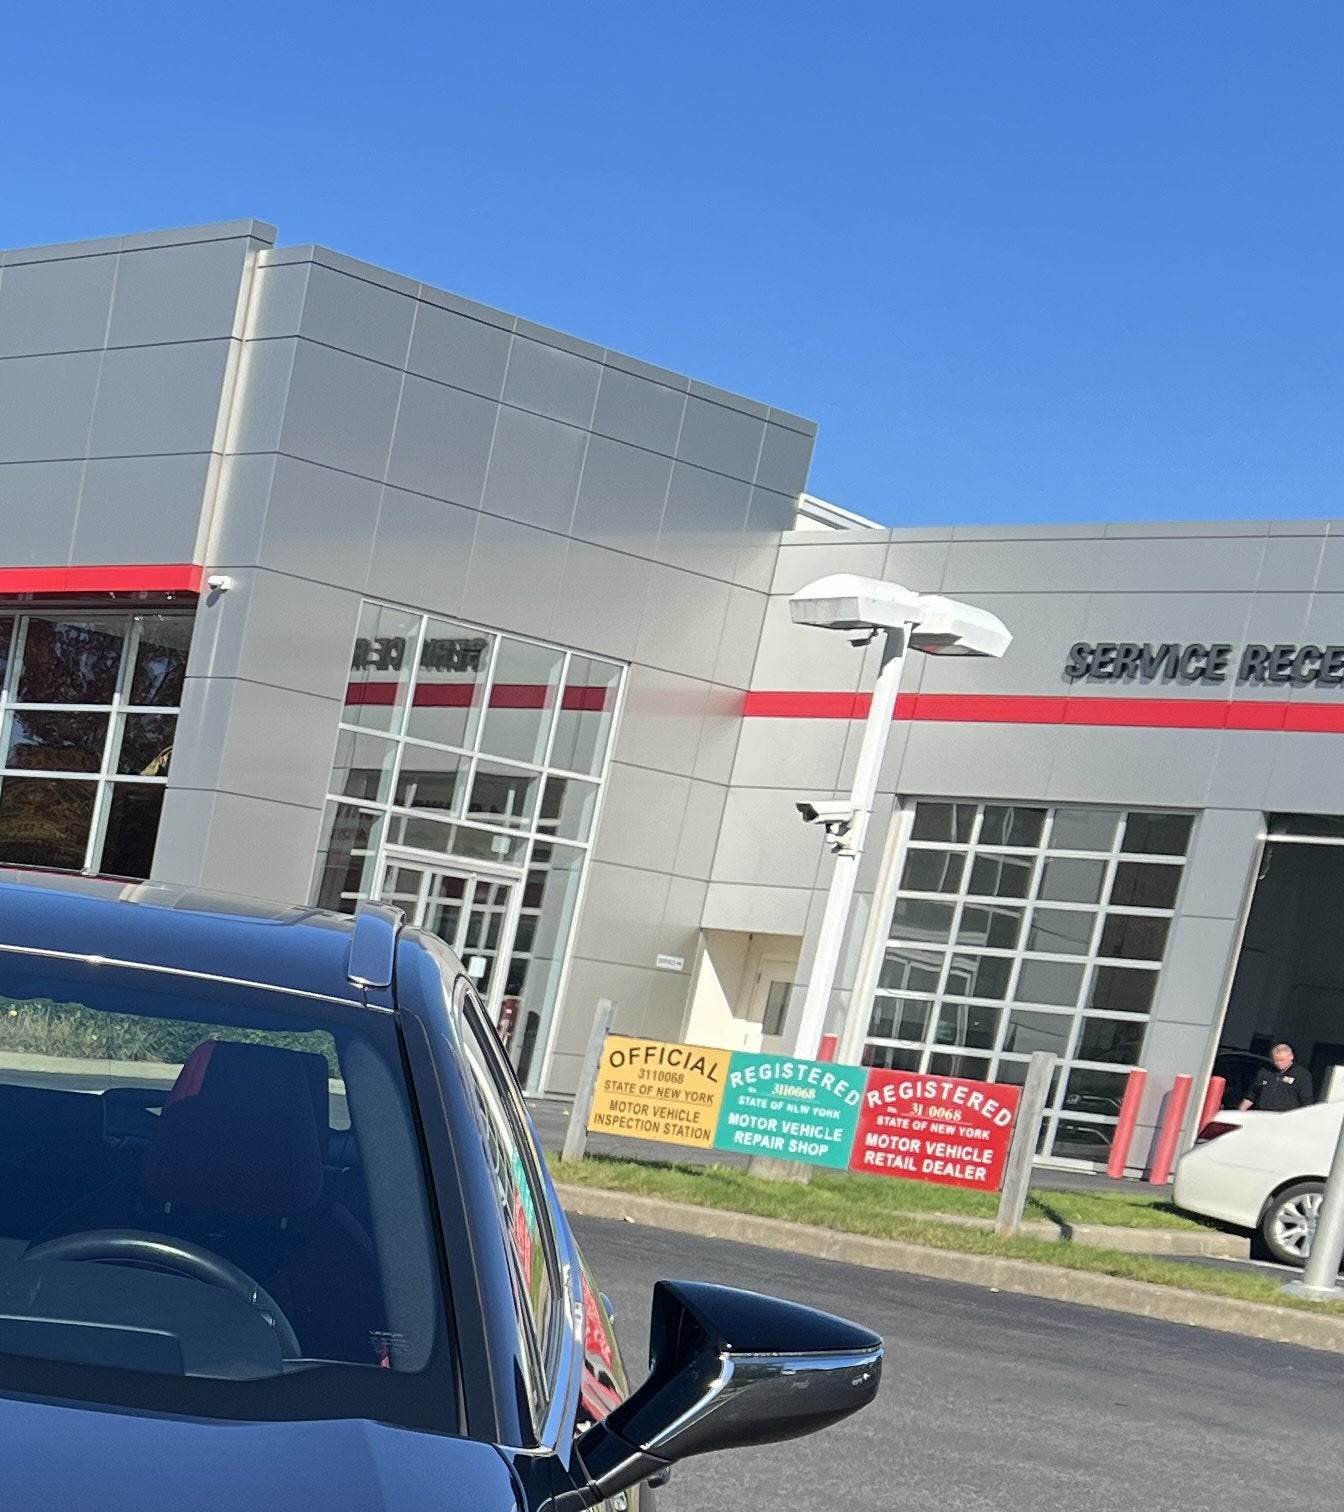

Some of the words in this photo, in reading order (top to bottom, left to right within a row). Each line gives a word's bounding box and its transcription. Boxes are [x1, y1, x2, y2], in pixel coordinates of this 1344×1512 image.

[1063, 642, 1233, 682] SERVICE
[609, 1046, 718, 1083] OFFICIAL
[638, 1068, 685, 1084] 3110068
[604, 1080, 636, 1092] STATE
[639, 1084, 653, 1096] OF
[656, 1087, 681, 1099] NEW
[684, 1091, 714, 1104] YORK
[730, 1062, 860, 1106] REGISTERED
[609, 1100, 649, 1116] MOTOR
[653, 1106, 700, 1124] VEHICLE
[738, 1095, 768, 1109] STATE
[770, 1100, 784, 1111] OF
[866, 1081, 1012, 1127] REGISTERED
[594, 1113, 660, 1133] INSPECTION
[663, 1123, 711, 1141] STATION
[728, 1112, 778, 1132] MOTOR
[782, 1120, 843, 1142] VEHICLE
[877, 1115, 910, 1129] STATE
[912, 1120, 928, 1132] OF
[930, 1123, 956, 1136] NEW
[959, 1126, 992, 1141] YORK
[734, 1130, 785, 1151] REPAIR
[788, 1139, 829, 1157] SHOP
[865, 1132, 921, 1154] MOTOR
[925, 1141, 993, 1165] VEHICLE
[864, 1150, 917, 1172] RETAIL
[922, 1159, 987, 1182] DEALER
